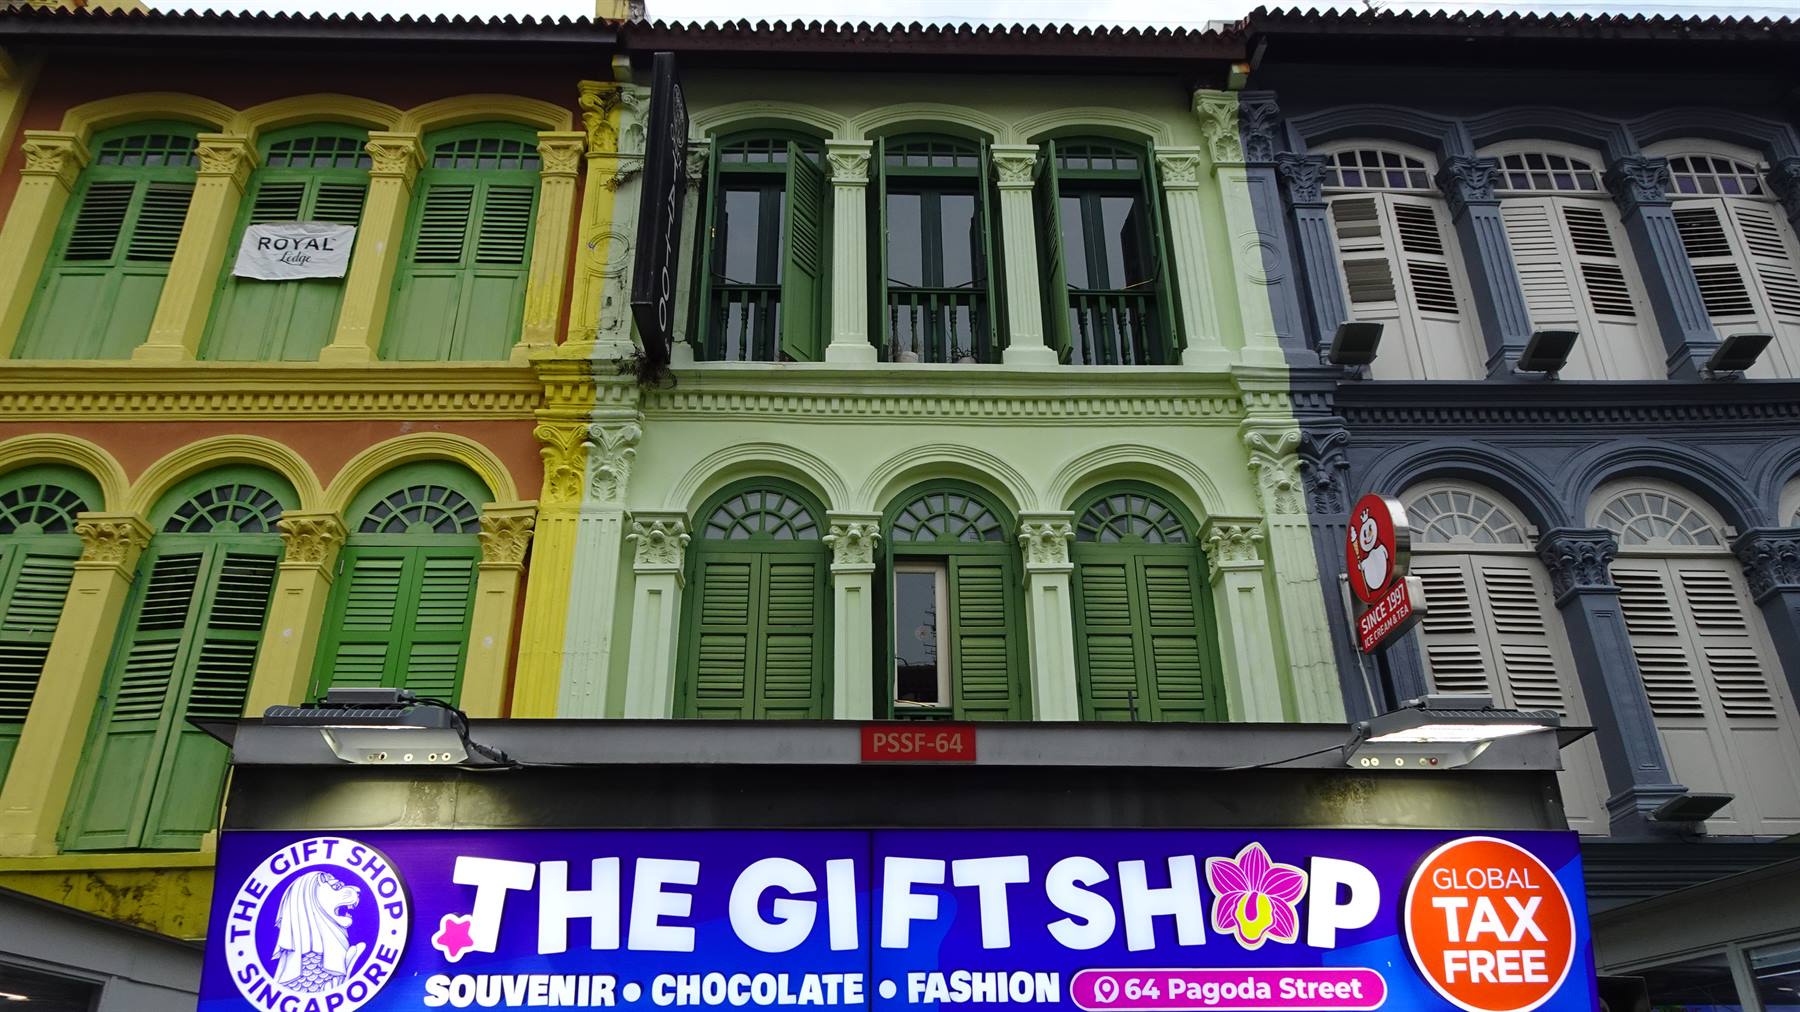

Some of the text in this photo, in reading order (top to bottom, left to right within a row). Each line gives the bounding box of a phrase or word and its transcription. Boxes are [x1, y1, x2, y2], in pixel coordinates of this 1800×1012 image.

[257, 236, 335, 251] ROYAL
[1361, 585, 1405, 634] SINCE 1997
[1364, 634, 1374, 649] ICE
[873, 732, 963, 753] PSSF-64
[229, 839, 403, 943] THE GIFT SHOP
[1432, 867, 1541, 890] GLOBAL
[452, 843, 1381, 955] THE GIFT SHP
[1431, 896, 1549, 943] TAX
[237, 943, 398, 1012] SINGAPORE
[1442, 949, 1550, 984] FREE
[424, 970, 1060, 1007] SOUVENIR CHOCOLATE FASHION
[1124, 977, 1364, 1005] 64 Pagoda Street
